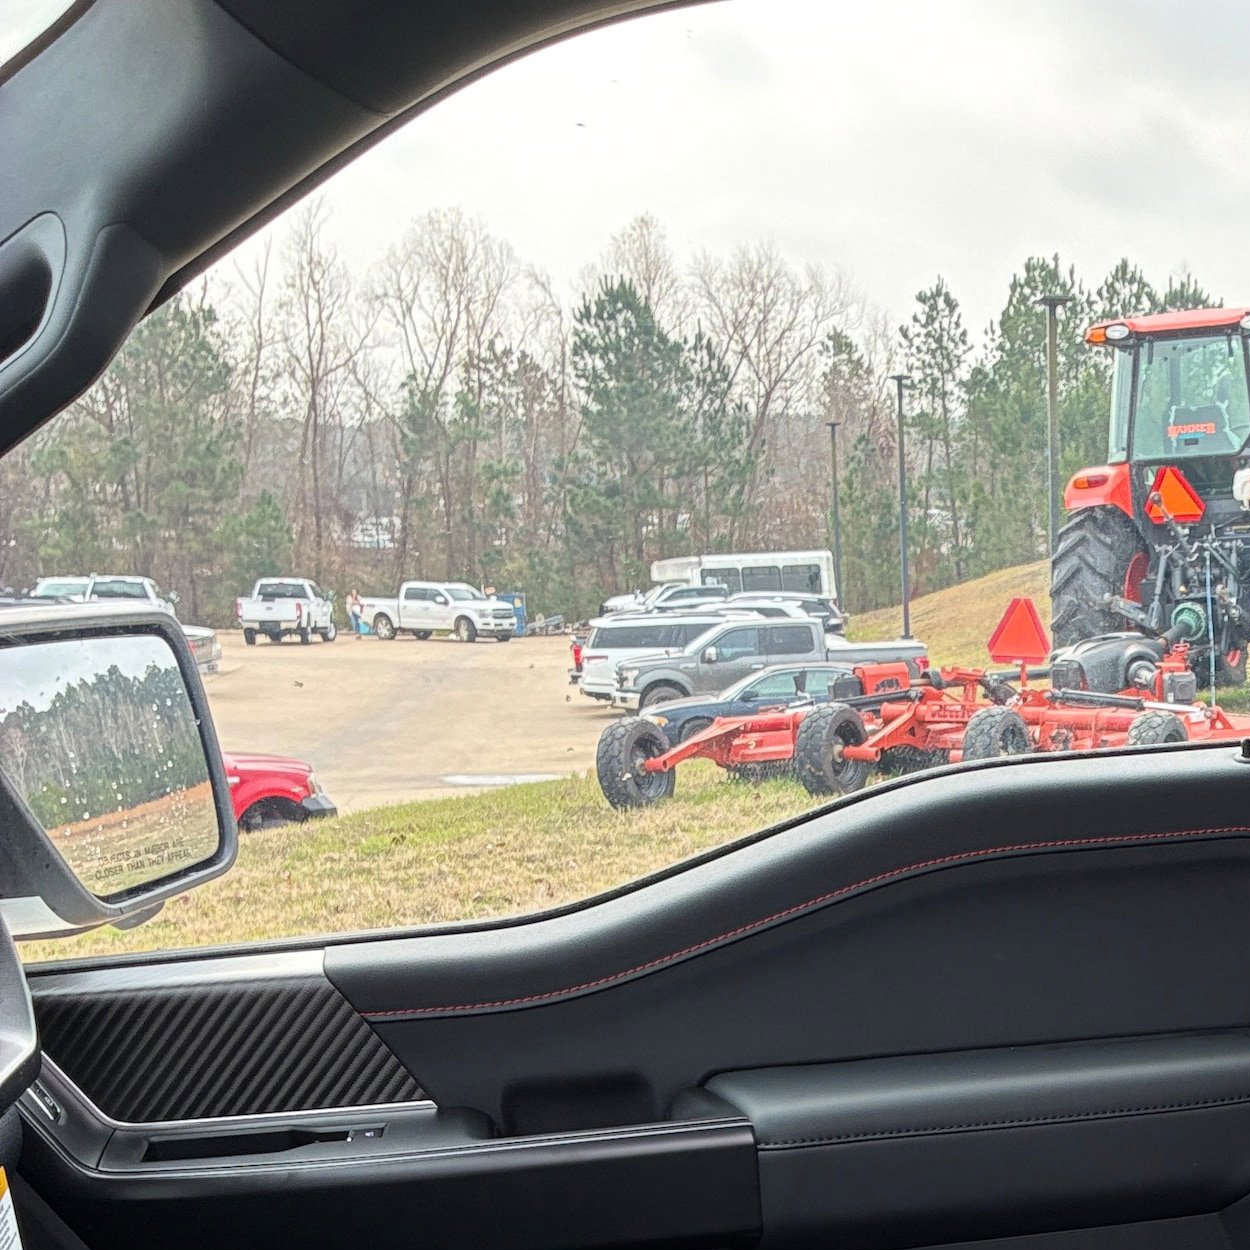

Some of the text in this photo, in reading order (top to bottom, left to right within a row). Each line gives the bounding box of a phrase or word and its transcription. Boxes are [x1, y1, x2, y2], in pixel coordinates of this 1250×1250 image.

[95, 865, 125, 880] CLOSER
[127, 860, 145, 871] THAN
[149, 855, 165, 866] THEY
